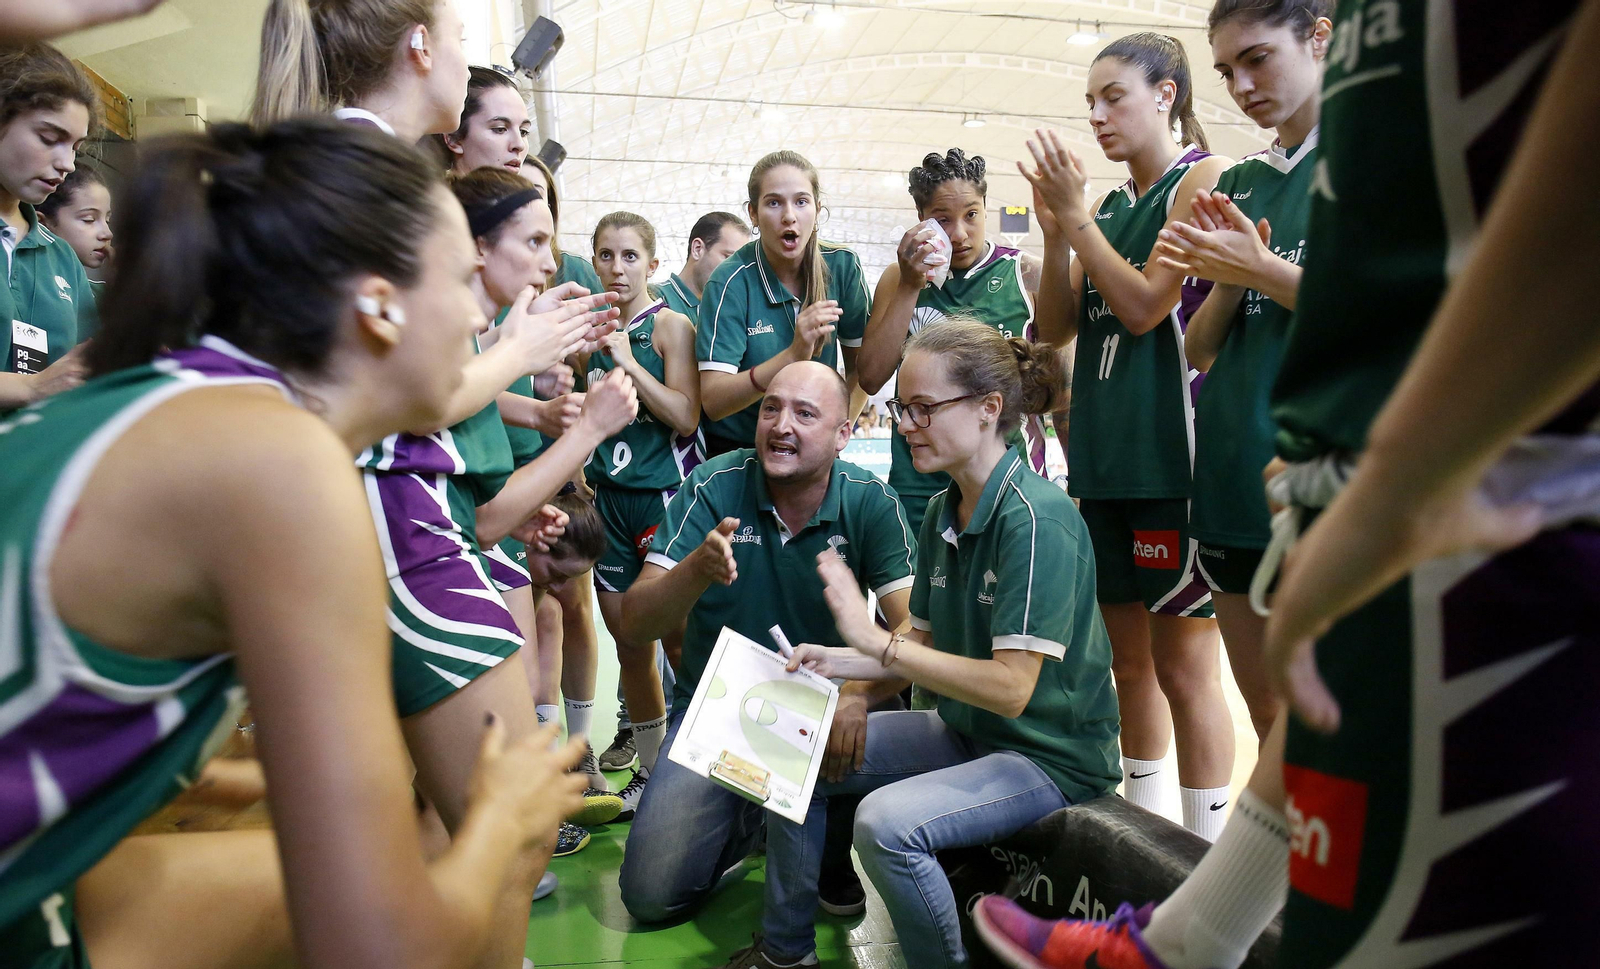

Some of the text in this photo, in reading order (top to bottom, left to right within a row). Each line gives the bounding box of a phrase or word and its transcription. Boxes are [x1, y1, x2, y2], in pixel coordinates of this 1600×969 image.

[1098, 333, 1120, 381] 11
[610, 441, 633, 476] 9
[598, 563, 625, 573] SPALDING
